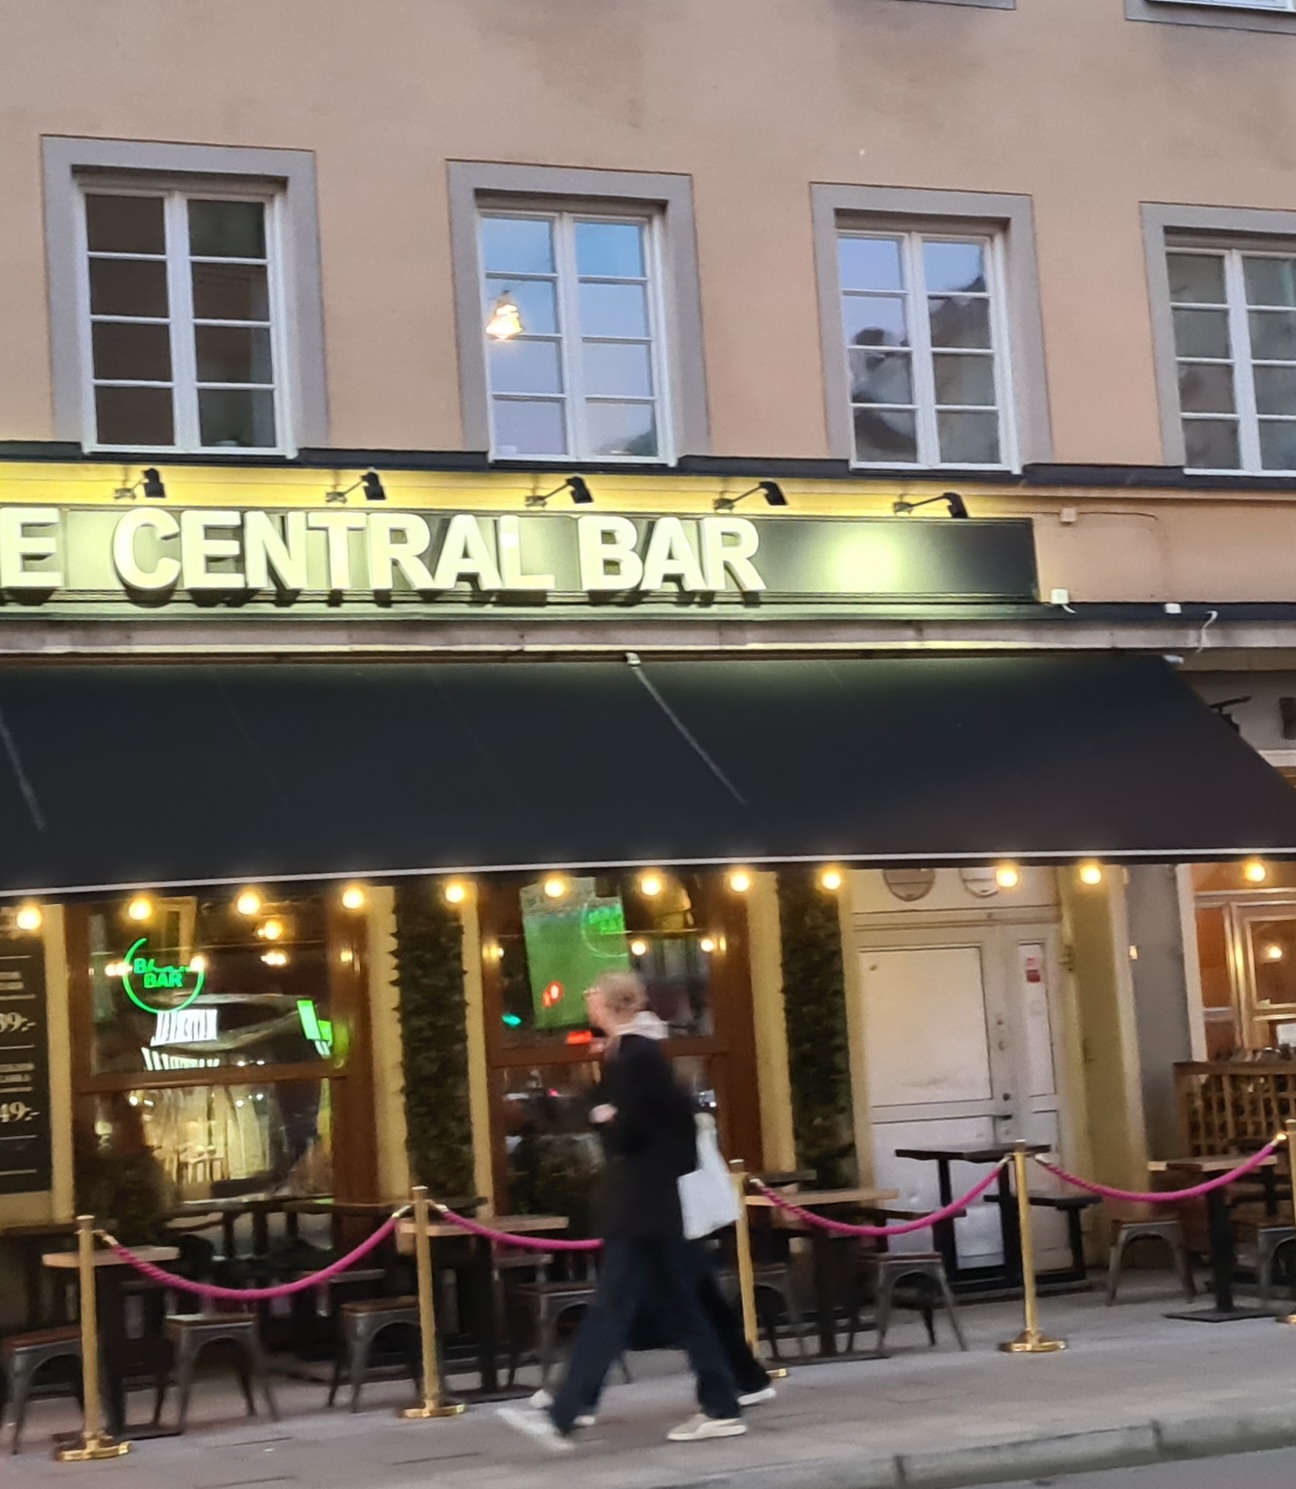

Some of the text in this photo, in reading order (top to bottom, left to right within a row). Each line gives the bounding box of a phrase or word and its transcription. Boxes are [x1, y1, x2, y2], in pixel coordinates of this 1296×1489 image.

[112, 506, 555, 590] CENTRAL
[577, 514, 767, 591] BAR
[144, 972, 183, 989] BAR
